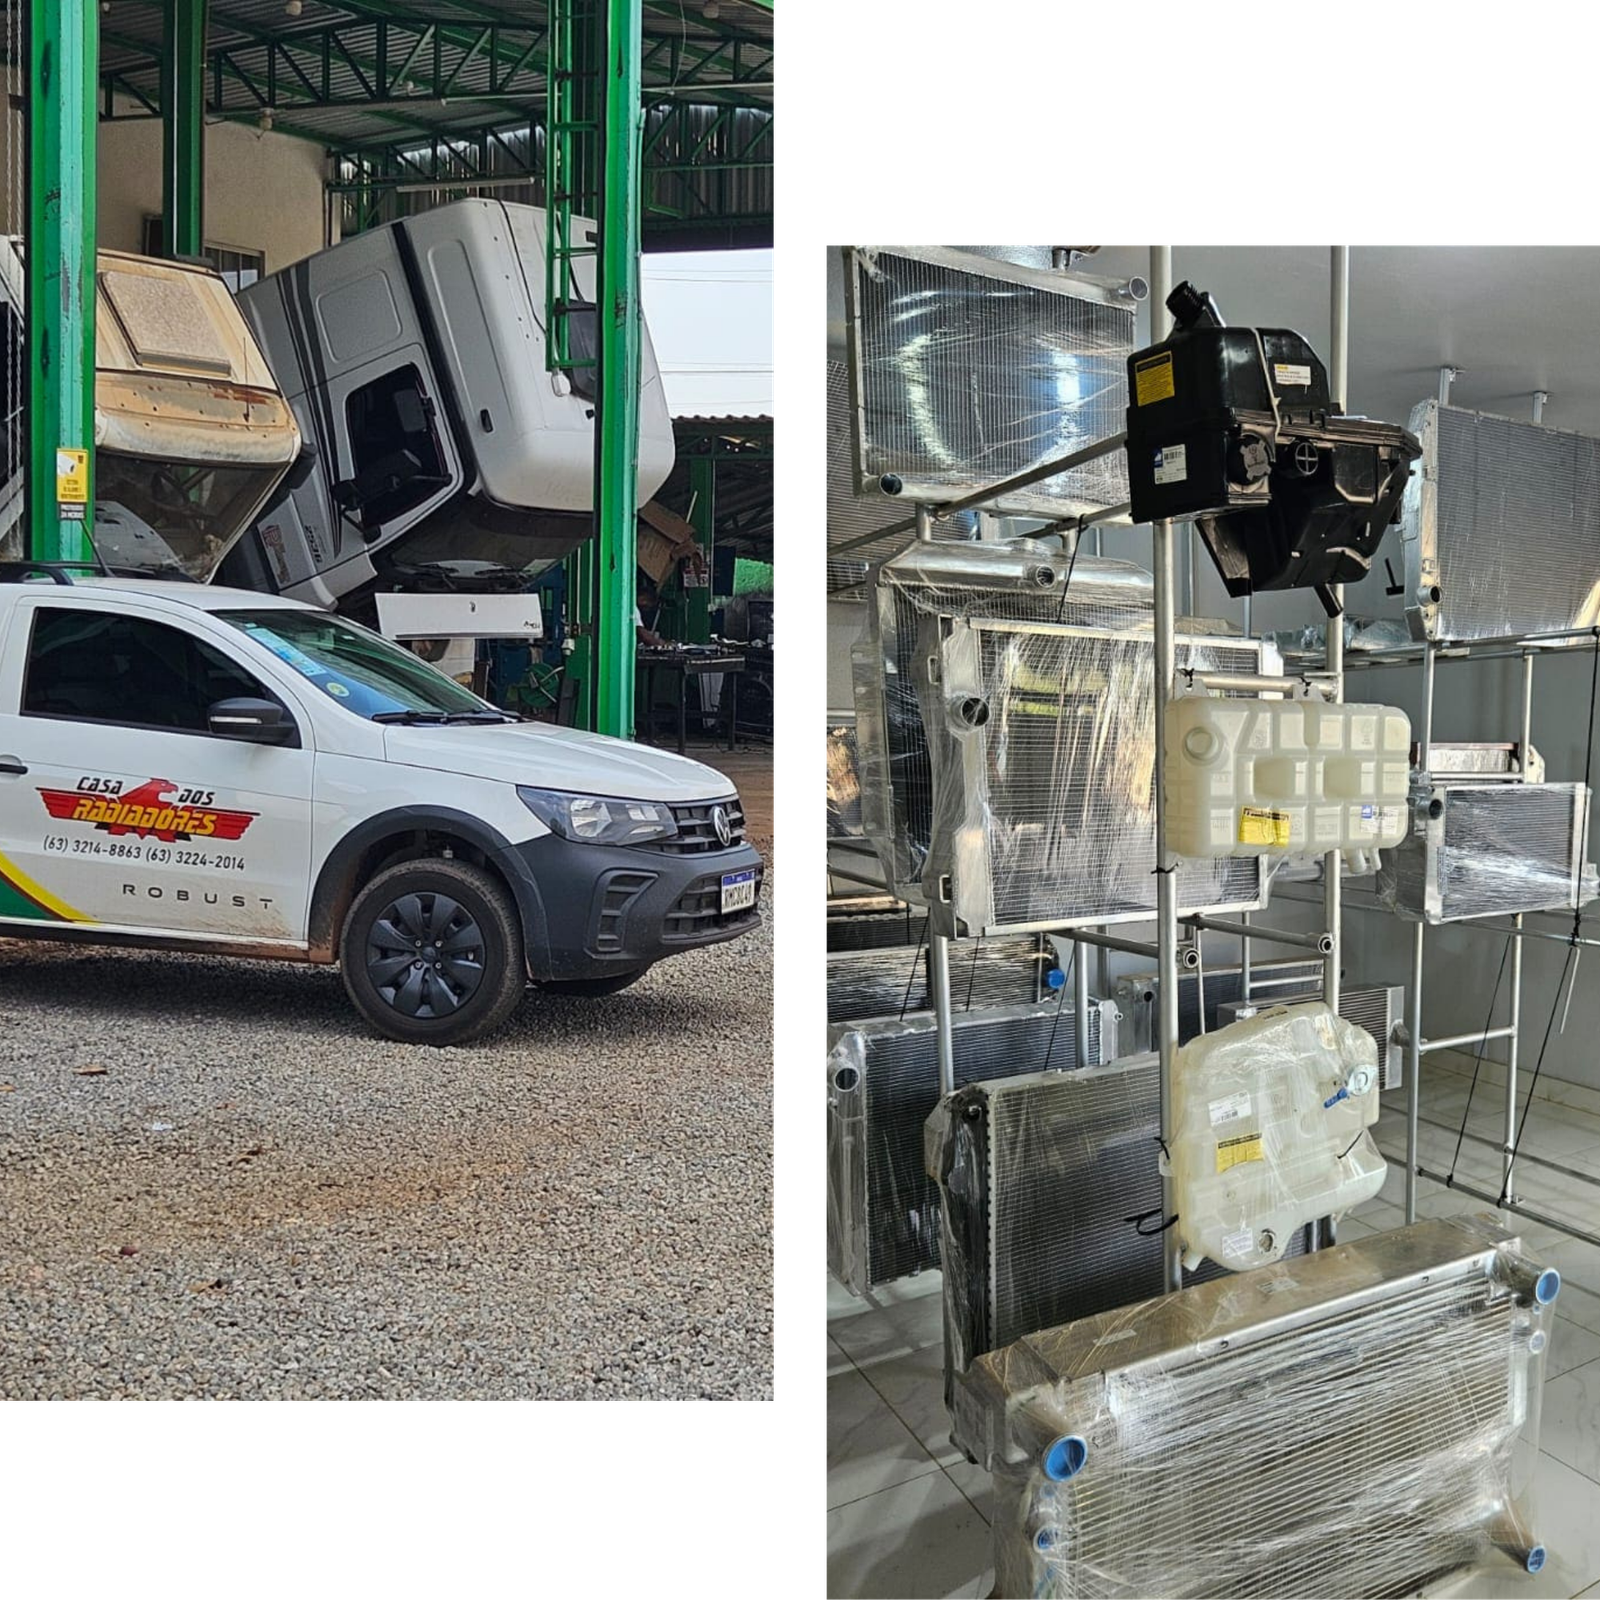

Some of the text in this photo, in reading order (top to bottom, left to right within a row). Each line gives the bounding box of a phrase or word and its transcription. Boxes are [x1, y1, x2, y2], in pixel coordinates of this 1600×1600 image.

[43, 834, 245, 870] (63) 3214-8863 (63) 3224-2014
[122, 884, 273, 909] ROBUST
